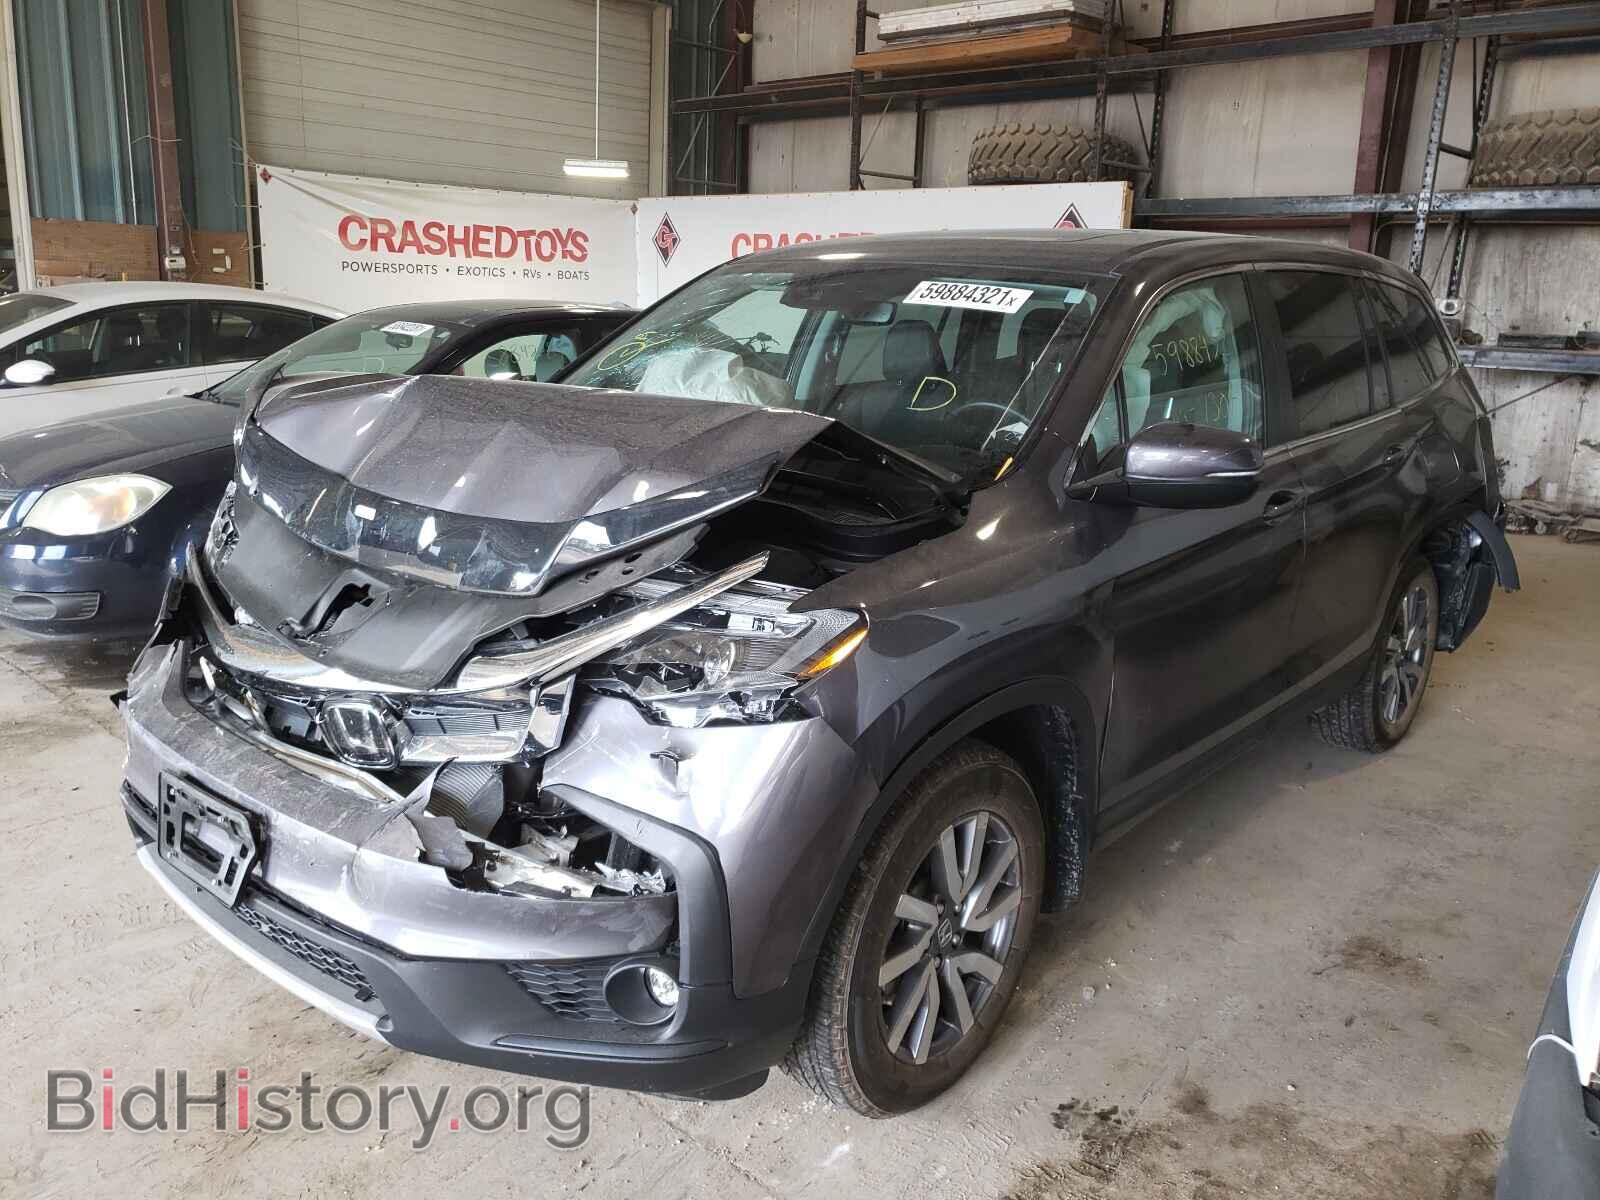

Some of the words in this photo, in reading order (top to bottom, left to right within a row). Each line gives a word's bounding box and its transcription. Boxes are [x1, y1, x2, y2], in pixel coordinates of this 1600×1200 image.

[337, 214, 590, 263] CRASHEDTOYS
[341, 260, 439, 275] POWERSPORTS
[457, 265, 506, 278] EXOTICS
[523, 268, 542, 279] RVs
[557, 270, 590, 281] BOATS
